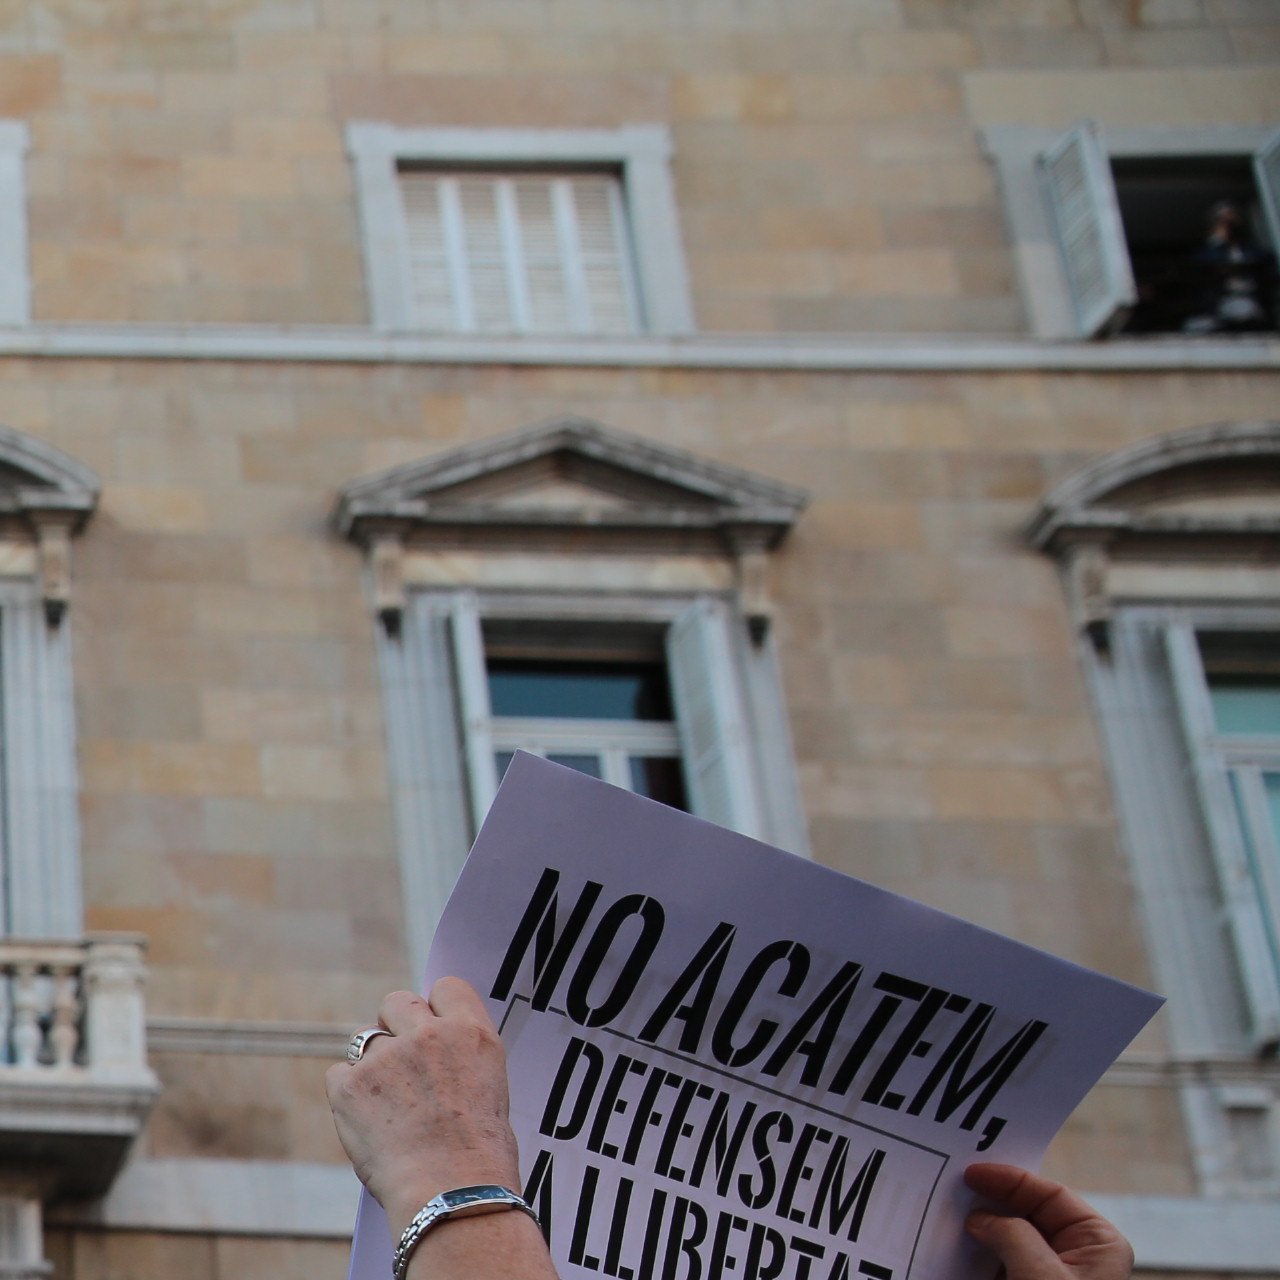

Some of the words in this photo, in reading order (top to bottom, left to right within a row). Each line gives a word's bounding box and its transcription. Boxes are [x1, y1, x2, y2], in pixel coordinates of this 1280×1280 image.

[490, 867, 666, 1028] NO
[638, 922, 1049, 1153] ACATEM,
[539, 1037, 887, 1242] DEFENSEM
